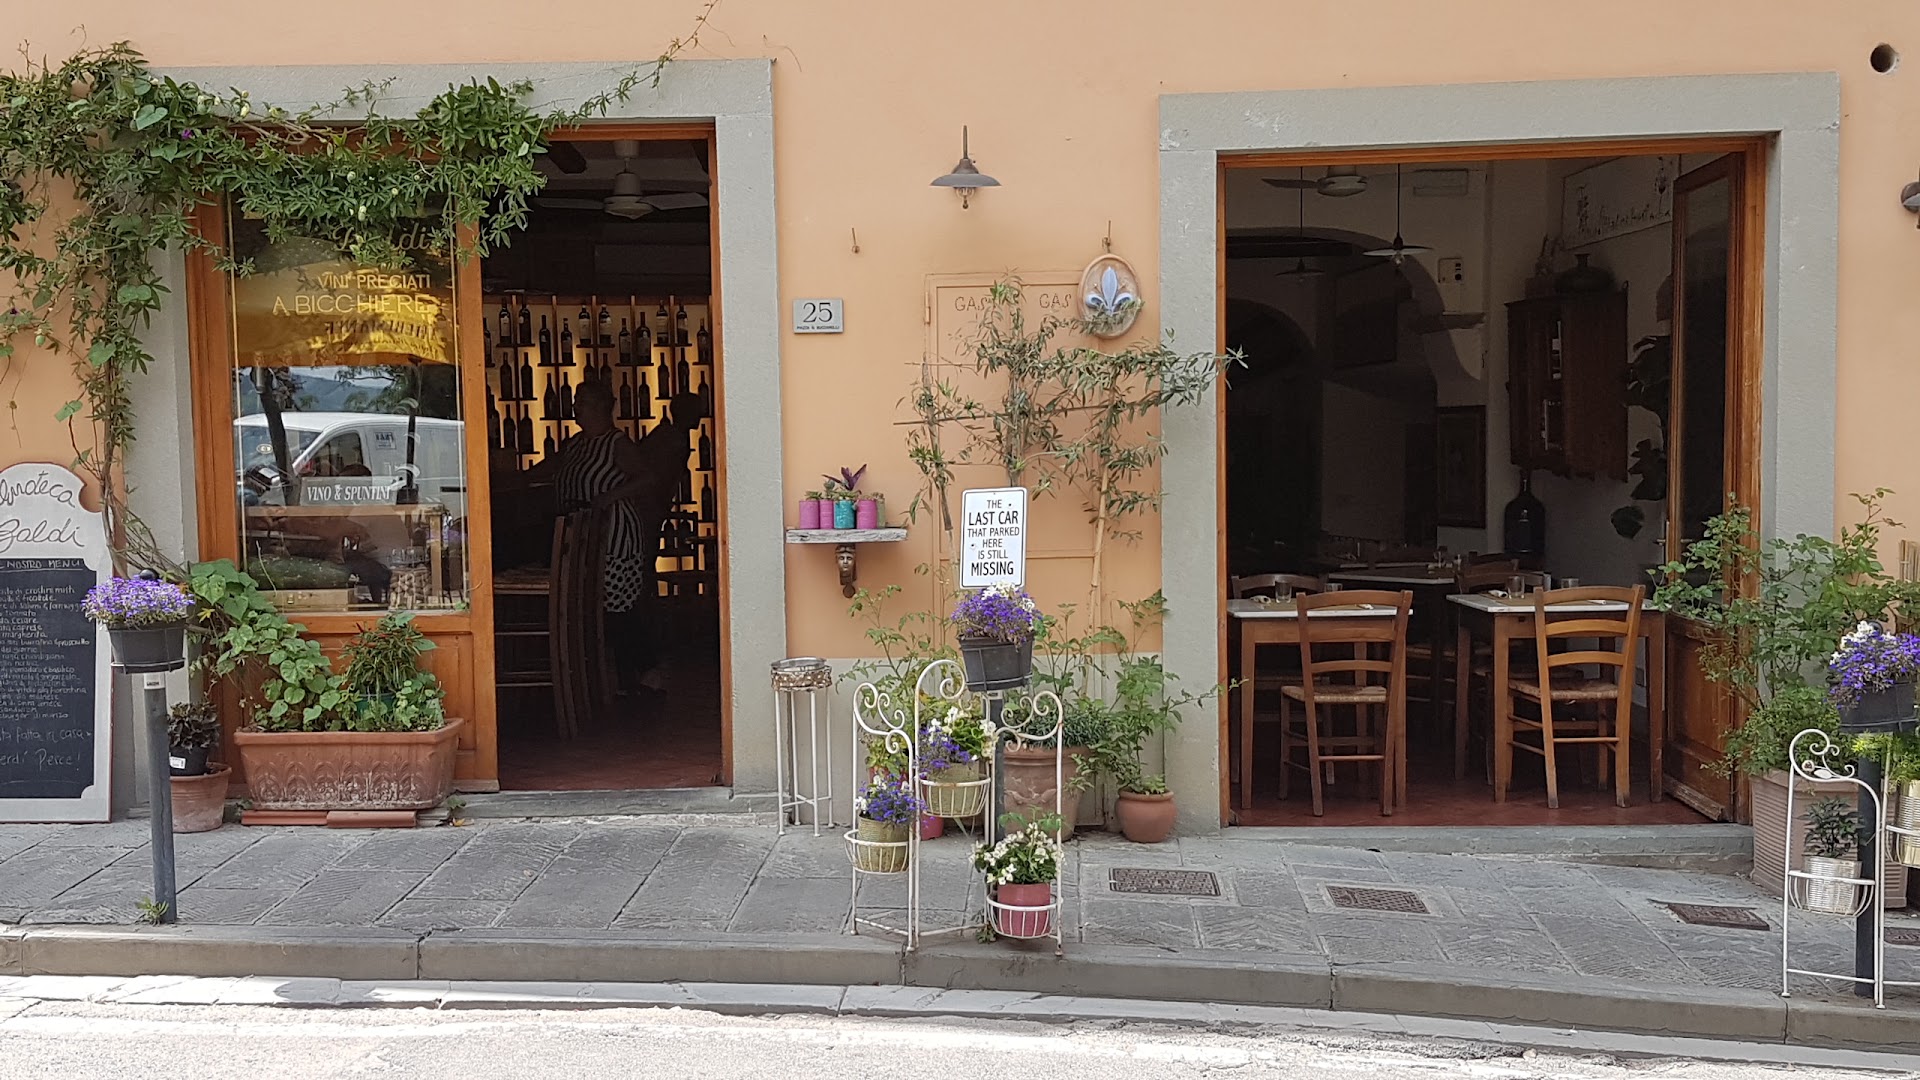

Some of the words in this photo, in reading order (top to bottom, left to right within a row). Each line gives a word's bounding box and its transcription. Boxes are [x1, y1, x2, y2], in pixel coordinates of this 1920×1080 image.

[317, 274, 349, 289] VINI
[272, 295, 290, 316] A
[295, 294, 430, 314] BICCHIERE
[954, 296, 988, 311] GAS
[1039, 293, 1072, 309] GAS
[803, 302, 833, 323] 25
[307, 486, 332, 500] VINO
[334, 487, 342, 500] &
[344, 486, 390, 500] SPUNTINI
[986, 499, 1003, 509] THE
[968, 511, 995, 526] LAST
[998, 510, 1019, 525] CAR
[967, 527, 987, 538] THAT
[989, 526, 1020, 537] PARKED
[982, 538, 1003, 548] HERE
[978, 550, 985, 560] IS
[987, 549, 1009, 559] STILL
[7, 560, 43, 570] NOSTRO
[48, 559, 80, 570] MENU
[971, 561, 1015, 576] MISSING
